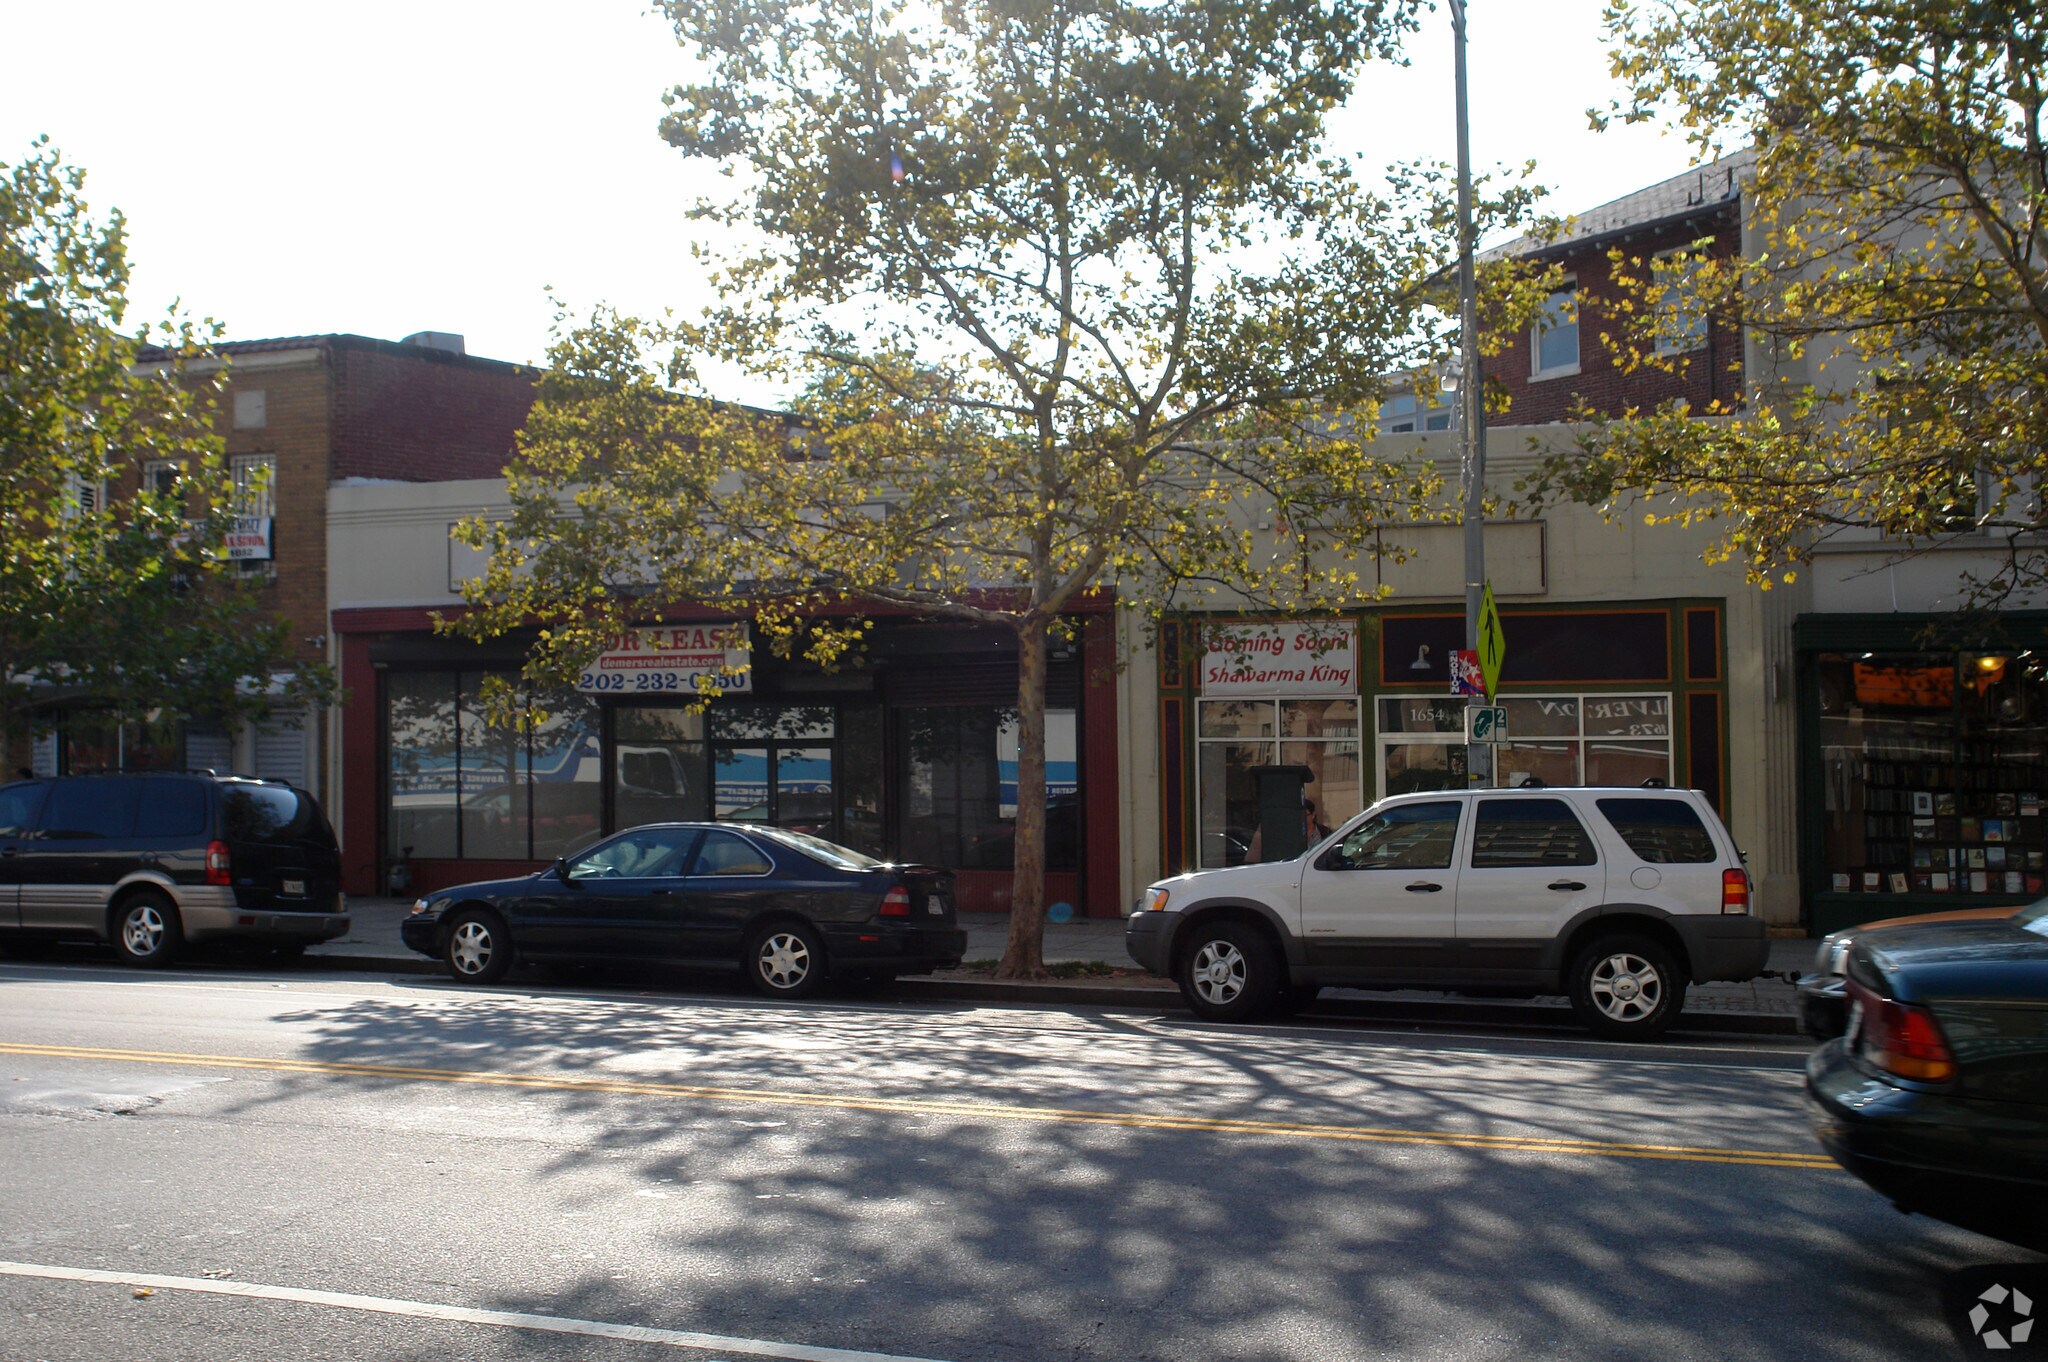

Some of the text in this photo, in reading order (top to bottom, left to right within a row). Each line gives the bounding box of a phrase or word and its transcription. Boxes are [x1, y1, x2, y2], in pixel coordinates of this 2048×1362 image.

[601, 631, 641, 651] OR
[1208, 632, 1349, 656] Coming Soon!
[602, 656, 724, 669] demersrealestate.com
[579, 673, 745, 690] 202-232-050
[1208, 665, 1351, 687] Shawarma King
[1410, 708, 1445, 722] 1654
[1496, 709, 1505, 723] 2
